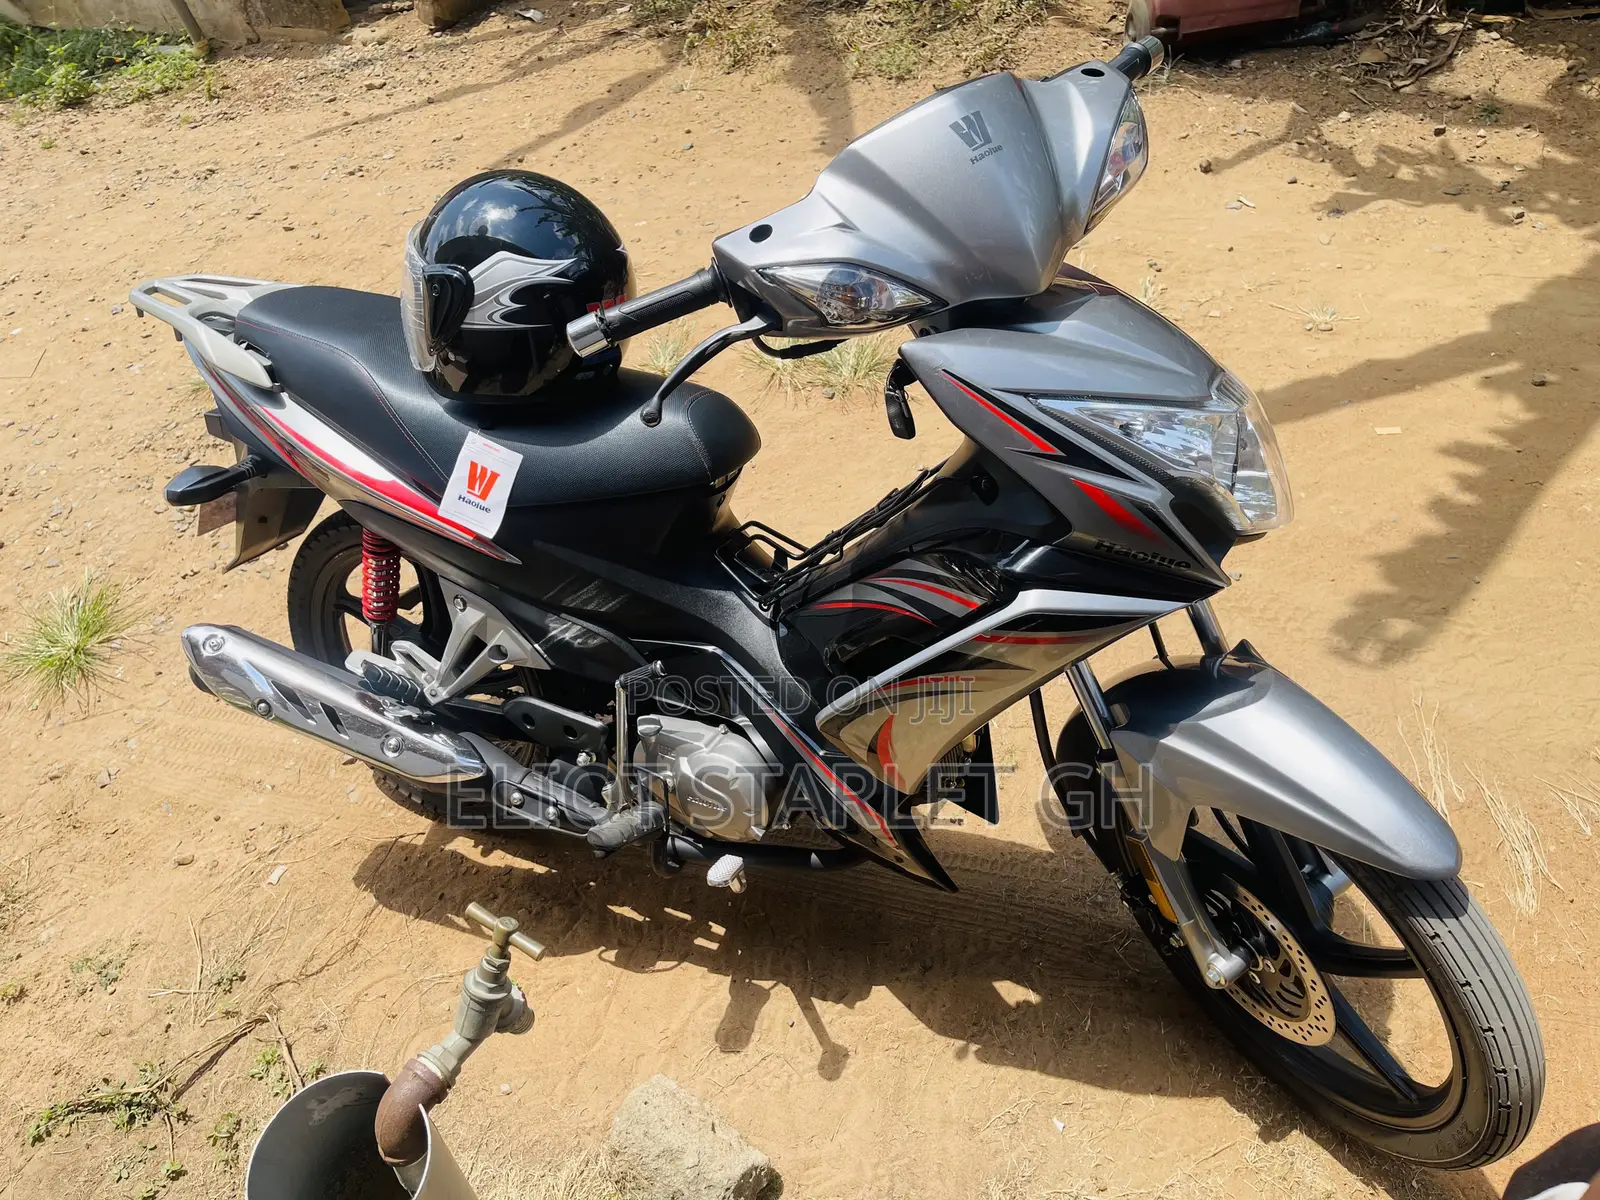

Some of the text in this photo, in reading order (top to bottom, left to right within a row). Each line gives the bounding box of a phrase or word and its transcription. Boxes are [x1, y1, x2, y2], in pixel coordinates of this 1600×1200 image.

[969, 144, 1003, 165] Haojue
[457, 494, 491, 513] Haojue
[1094, 539, 1191, 569] Haojue
